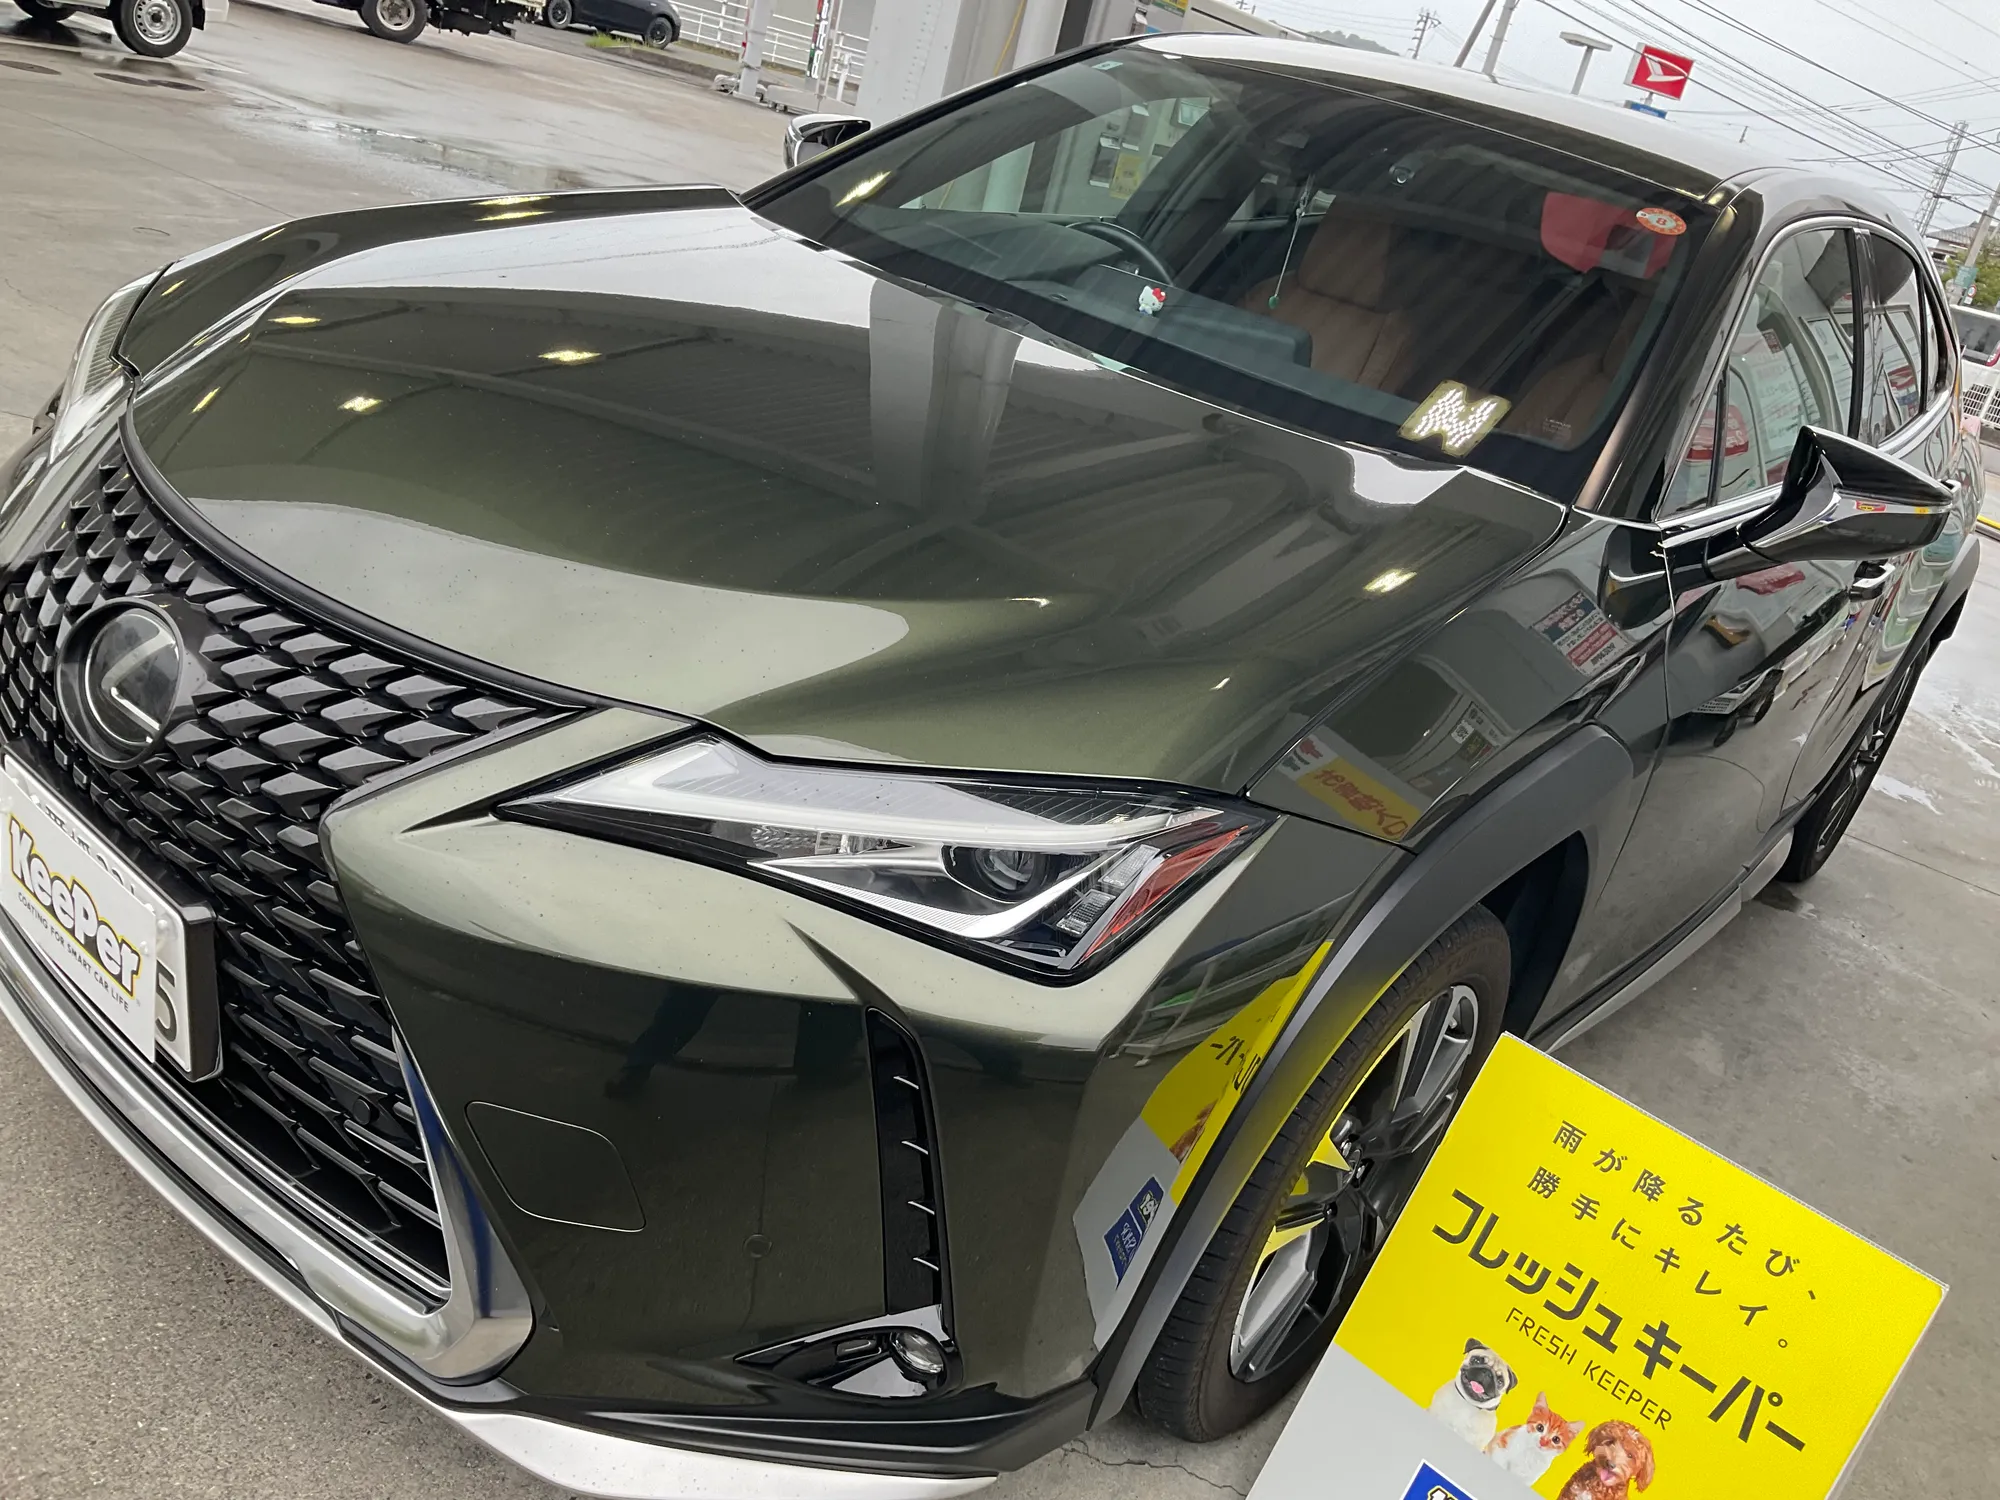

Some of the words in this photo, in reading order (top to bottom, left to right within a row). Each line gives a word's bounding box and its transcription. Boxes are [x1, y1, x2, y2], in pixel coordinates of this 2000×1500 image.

[17, 891, 49, 931] COATING
[50, 926, 66, 948] FOR
[67, 943, 92, 975] SMART
[93, 971, 110, 995] CAR
[111, 990, 130, 1013] LIFE
[1527, 1166, 1788, 1349] 勝手にキレイ。
[1552, 1119, 1816, 1300] 雨が降るたび、
[1431, 1188, 1806, 1452] フレッシュキーパー
[1505, 1307, 1578, 1366] FRESH
[1582, 1360, 1673, 1431] KEEPER
